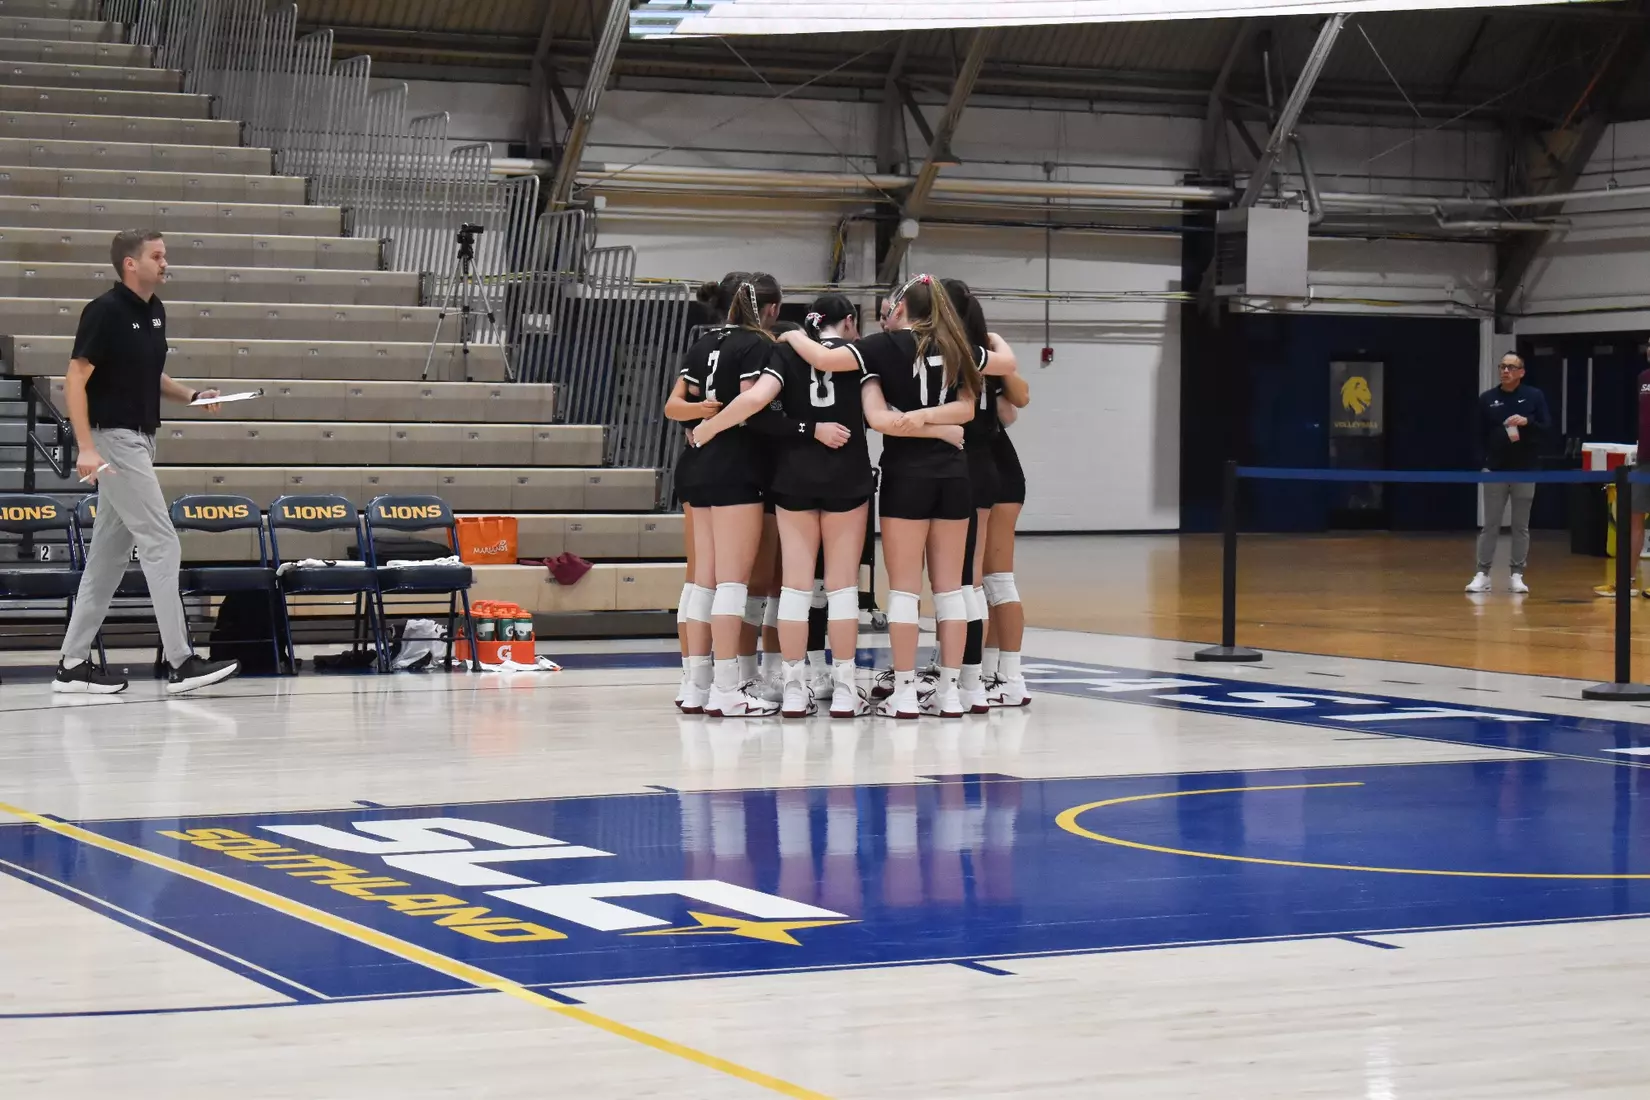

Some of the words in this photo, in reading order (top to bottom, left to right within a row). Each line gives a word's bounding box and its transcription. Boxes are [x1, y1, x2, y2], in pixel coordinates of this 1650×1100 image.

[0, 505, 57, 521] IONS
[182, 504, 249, 521] LIONS
[283, 504, 347, 520] LIONS
[379, 504, 442, 520] LIONS
[41, 545, 49, 560] 2
[497, 644, 512, 661] G
[155, 827, 569, 944] SOUTHLAND
